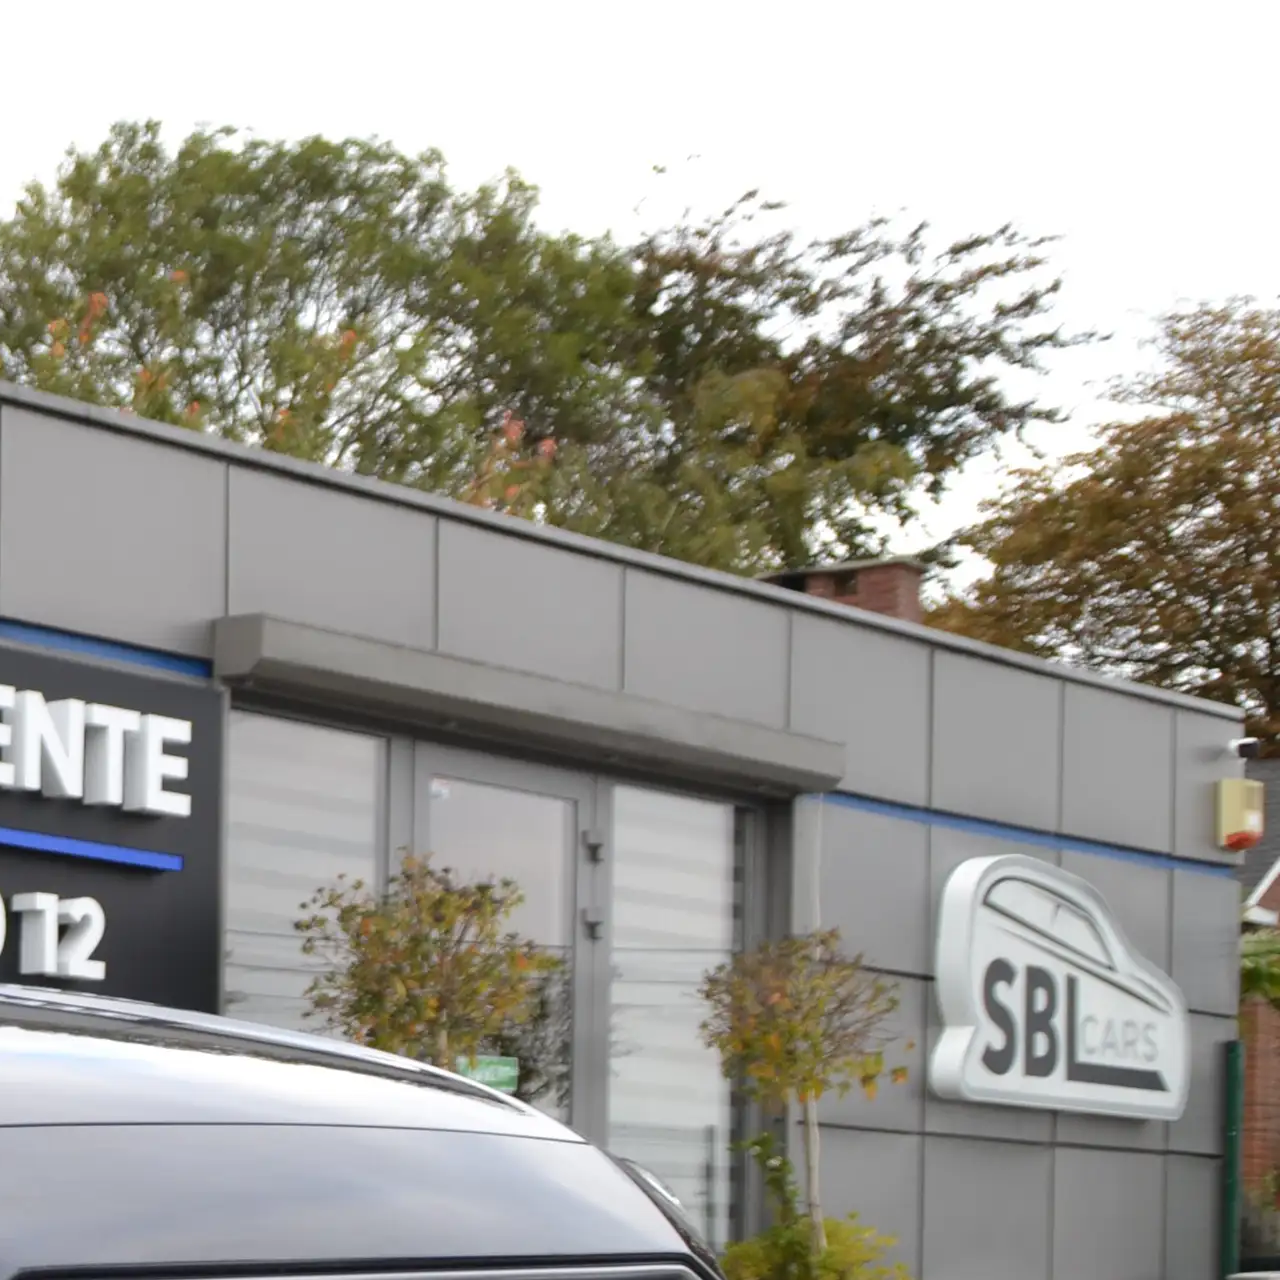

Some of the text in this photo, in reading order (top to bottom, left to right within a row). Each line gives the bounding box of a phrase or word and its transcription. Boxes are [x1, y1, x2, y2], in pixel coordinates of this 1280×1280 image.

[11, 891, 107, 981] 12
[981, 956, 1170, 1093] SBL CARS
